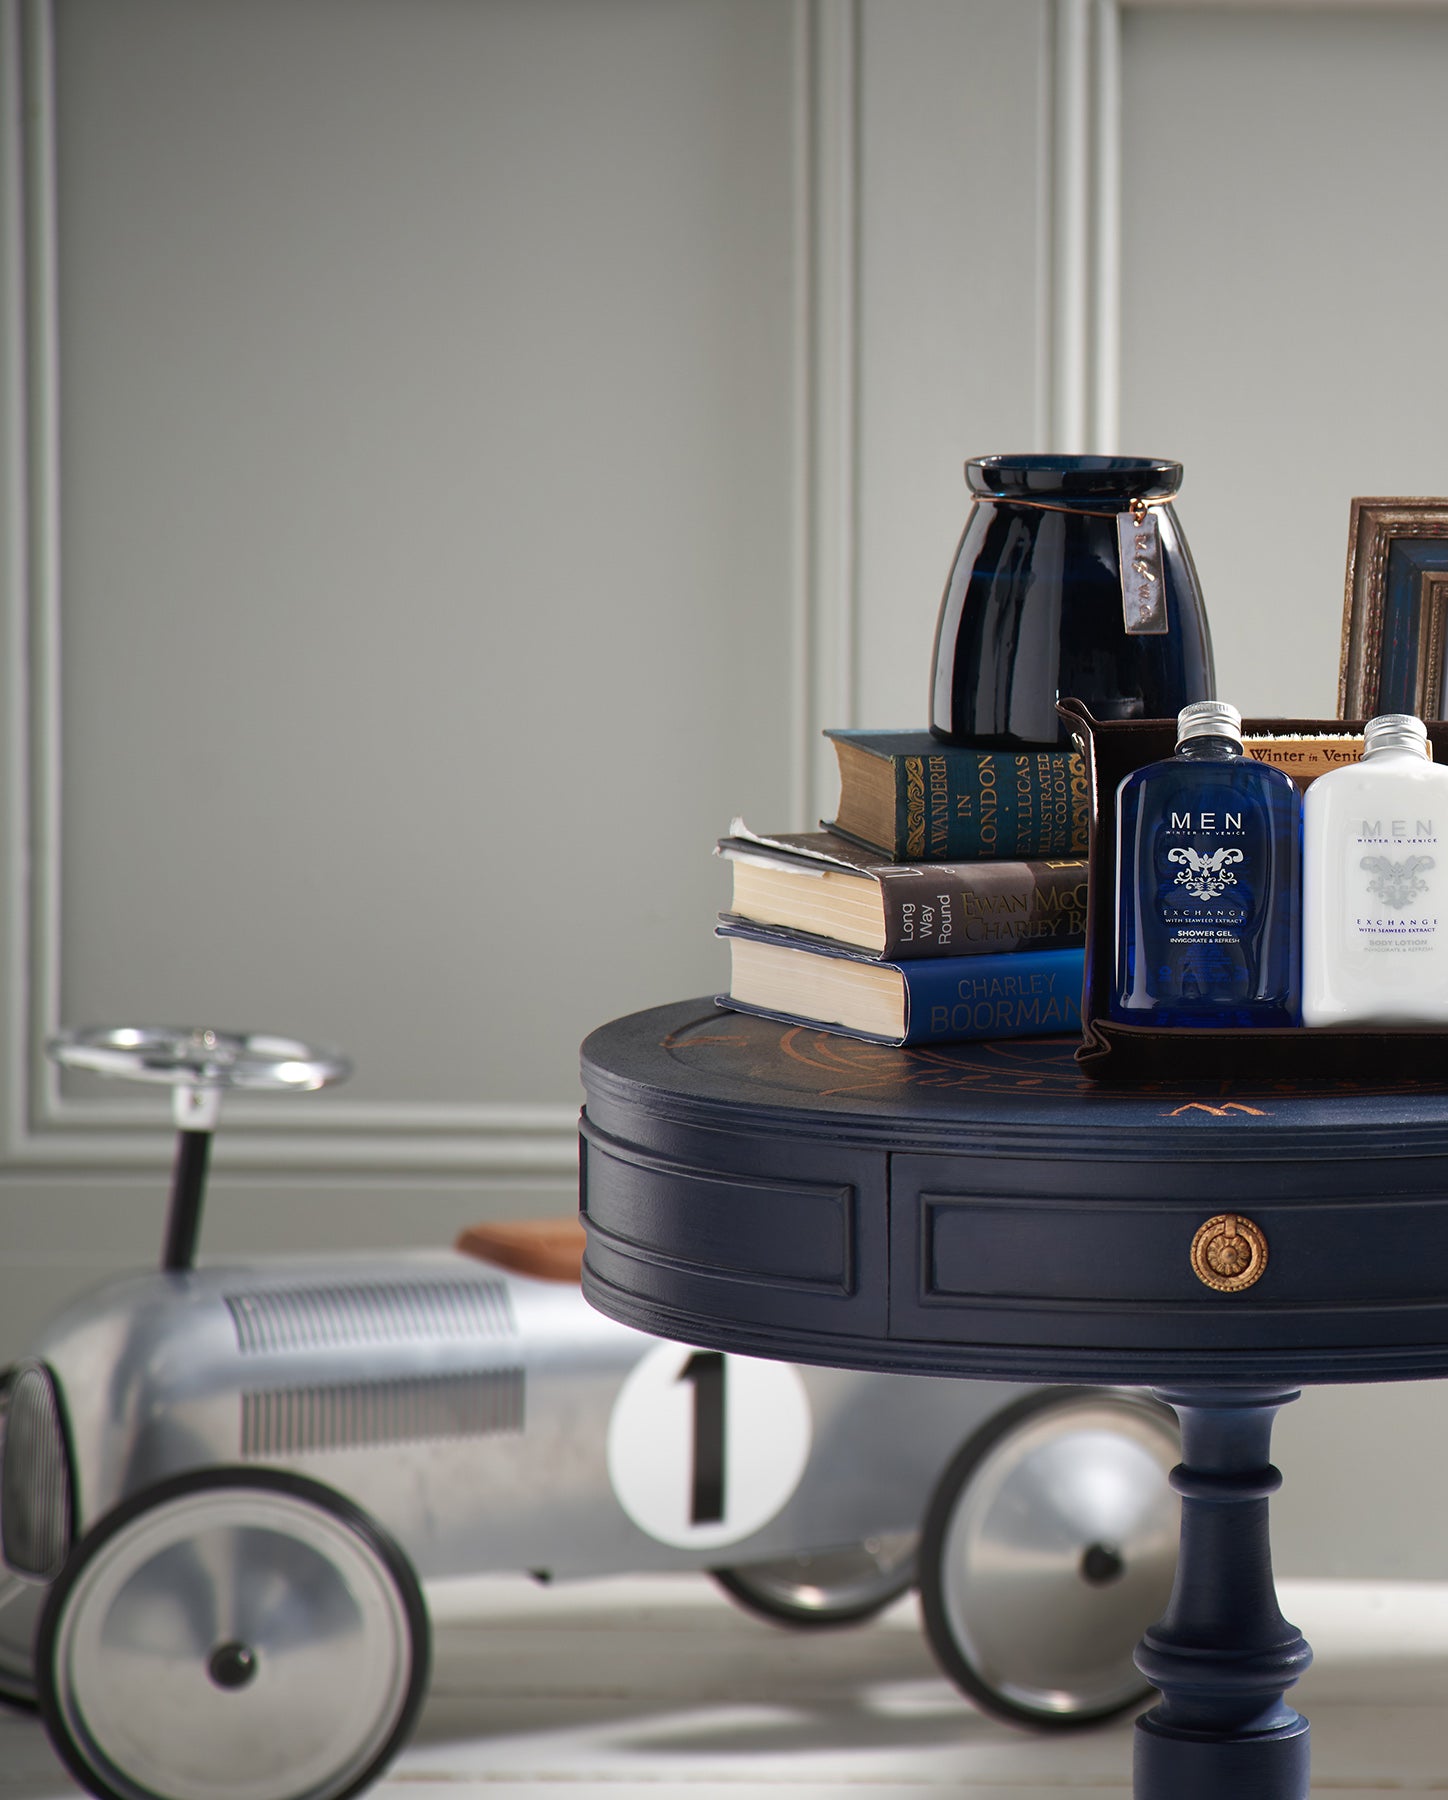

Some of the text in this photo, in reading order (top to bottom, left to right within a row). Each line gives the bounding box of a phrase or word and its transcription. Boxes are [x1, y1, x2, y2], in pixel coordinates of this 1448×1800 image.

[1249, 749, 1364, 762] Winter in Venic
[929, 754, 949, 844] WANDERER
[956, 794, 972, 817] IN
[977, 754, 998, 856] LONDON
[1037, 753, 1053, 853] ILLUSTRATED
[1171, 812, 1242, 830] MEN
[1361, 819, 1432, 837] MEN
[900, 903, 916, 942] Long
[919, 904, 935, 938] Way
[938, 894, 951, 945] Round
[958, 972, 1057, 1000] CHARLEY
[673, 1349, 728, 1527] 1
